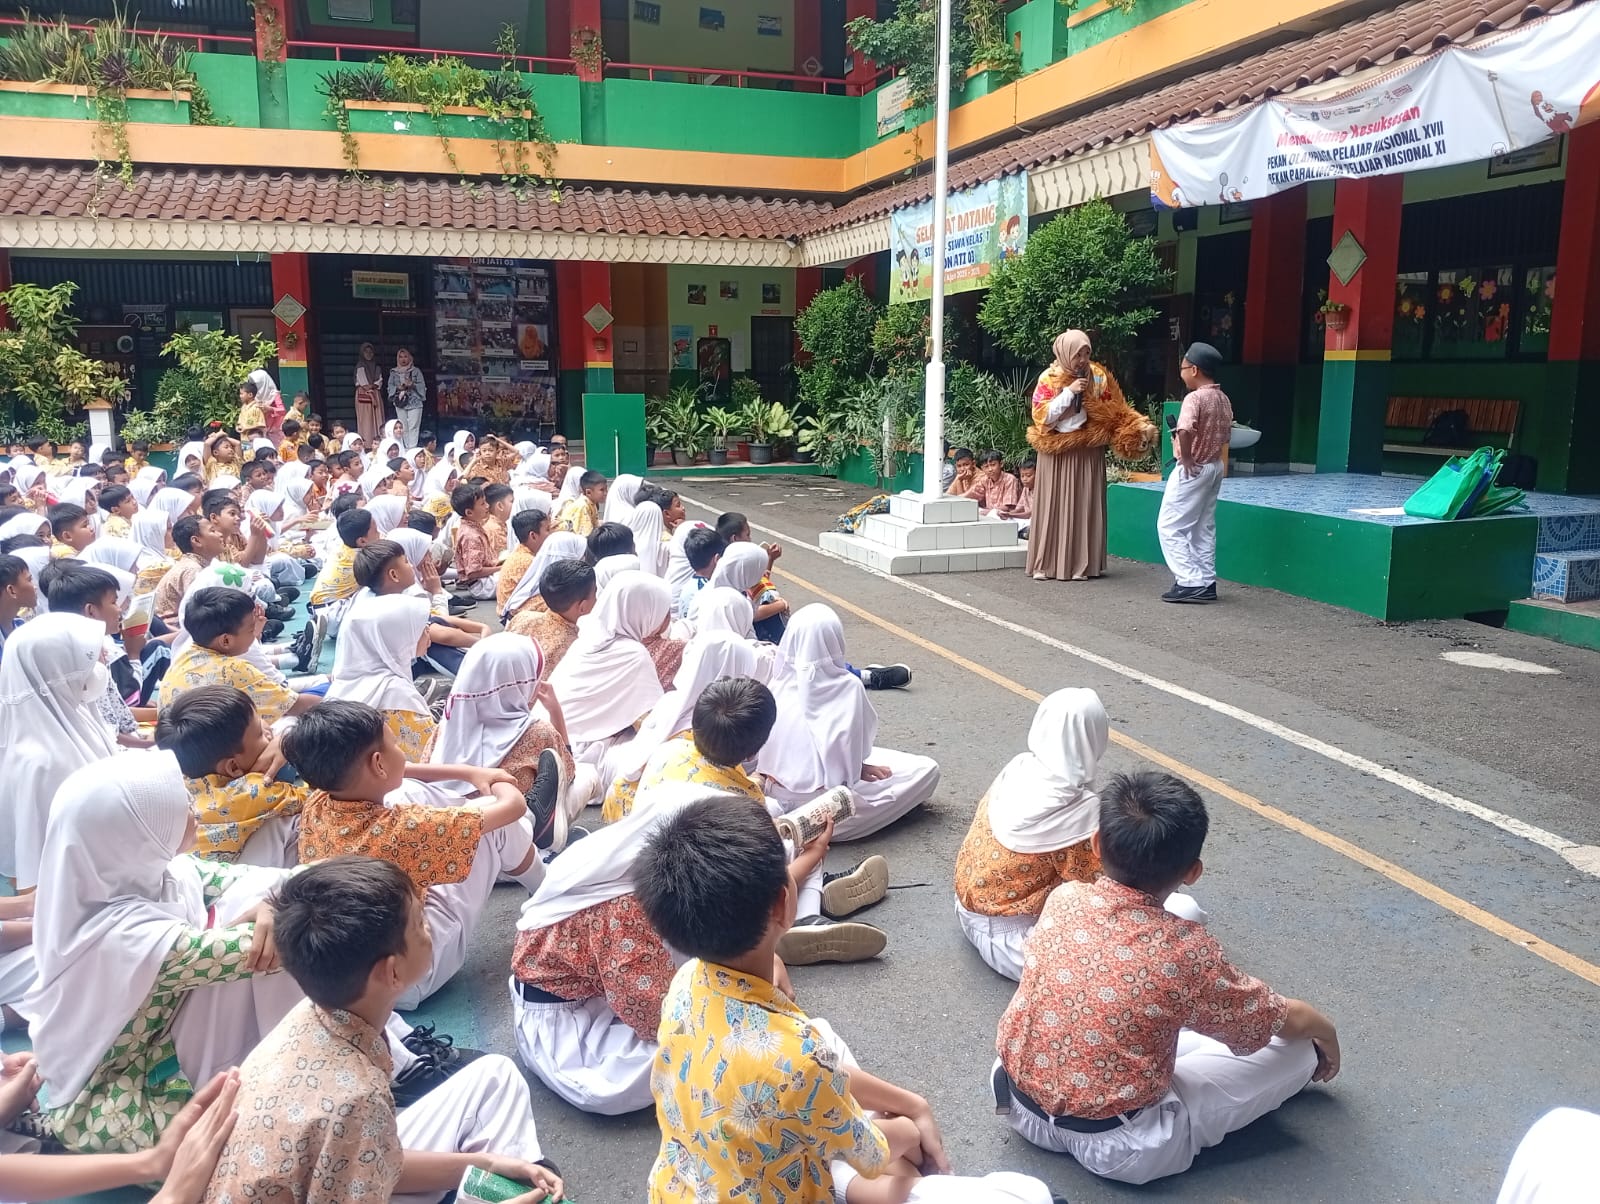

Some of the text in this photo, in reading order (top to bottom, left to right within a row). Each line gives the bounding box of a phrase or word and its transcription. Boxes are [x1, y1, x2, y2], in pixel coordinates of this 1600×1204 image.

[1350, 106, 1421, 138] Kesuksesan
[1267, 154, 1287, 170] PEKAN
[1333, 141, 1376, 162] PELAJAR
[1373, 130, 1421, 153] NASIONAL
[1424, 120, 1445, 139] XVII
[1268, 171, 1290, 185] PEKAN
[1344, 157, 1383, 176] PELAJAR
[1384, 146, 1433, 170] NASIONAL
[1435, 139, 1447, 155] XI
[916, 205, 995, 244] SELAAT DATANG
[968, 250, 975, 263] 03
